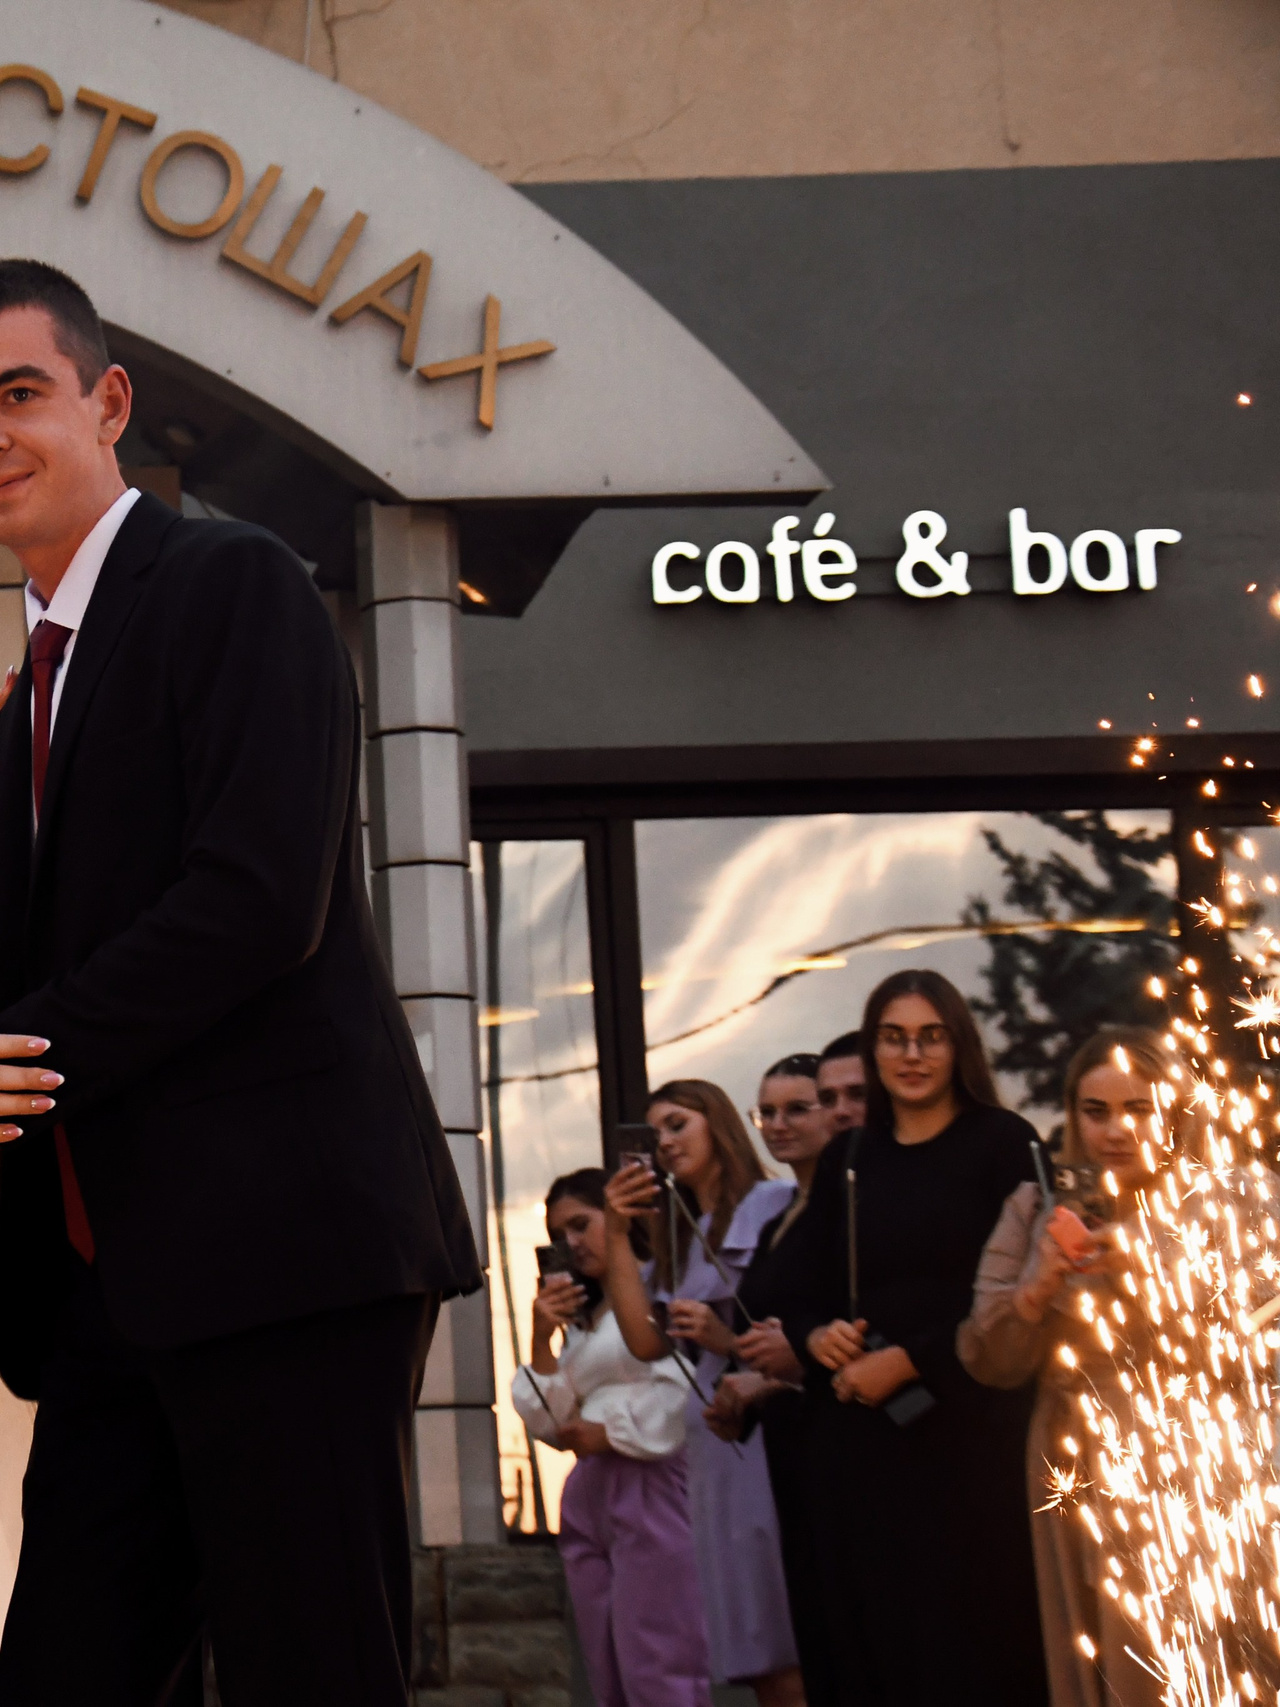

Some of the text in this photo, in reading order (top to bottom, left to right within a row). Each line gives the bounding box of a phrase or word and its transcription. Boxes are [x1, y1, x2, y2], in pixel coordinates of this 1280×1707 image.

[651, 507, 1183, 604] café & bar
